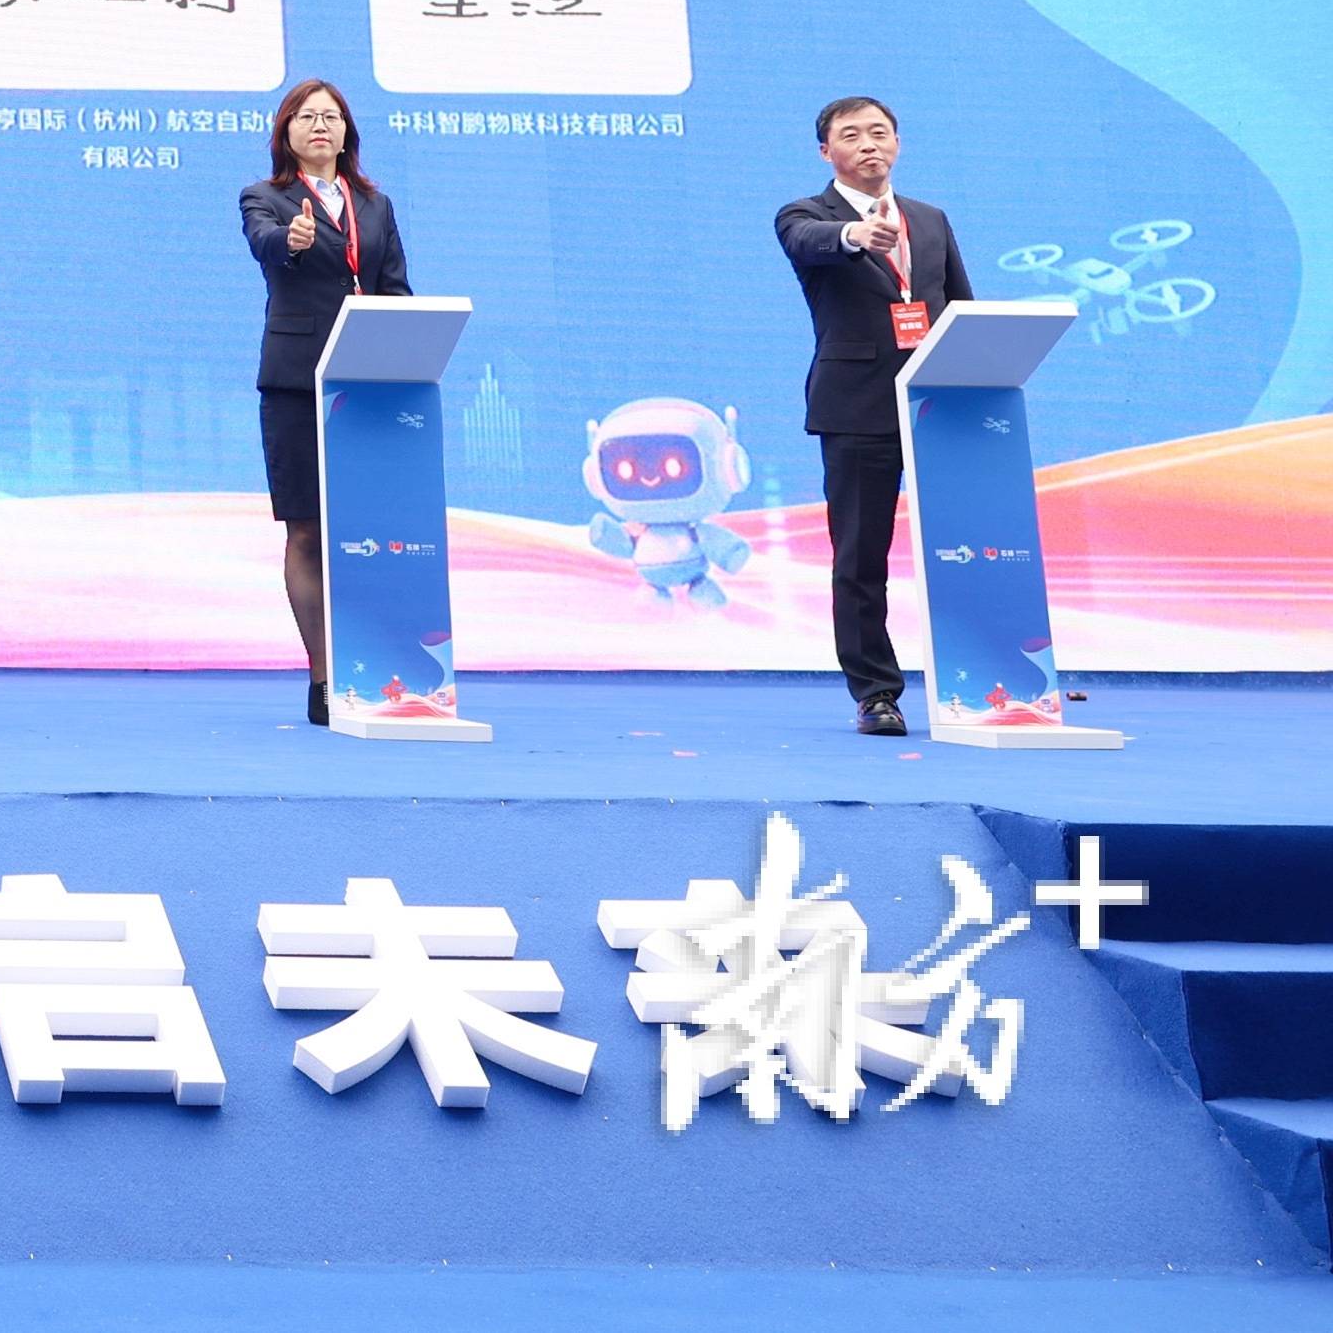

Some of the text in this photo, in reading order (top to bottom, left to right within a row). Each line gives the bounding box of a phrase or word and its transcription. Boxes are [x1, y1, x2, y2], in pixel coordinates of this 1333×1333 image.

[387, 111, 686, 136] 中科智鹏物联科技有限公司
[83, 146, 179, 169] 有限公司
